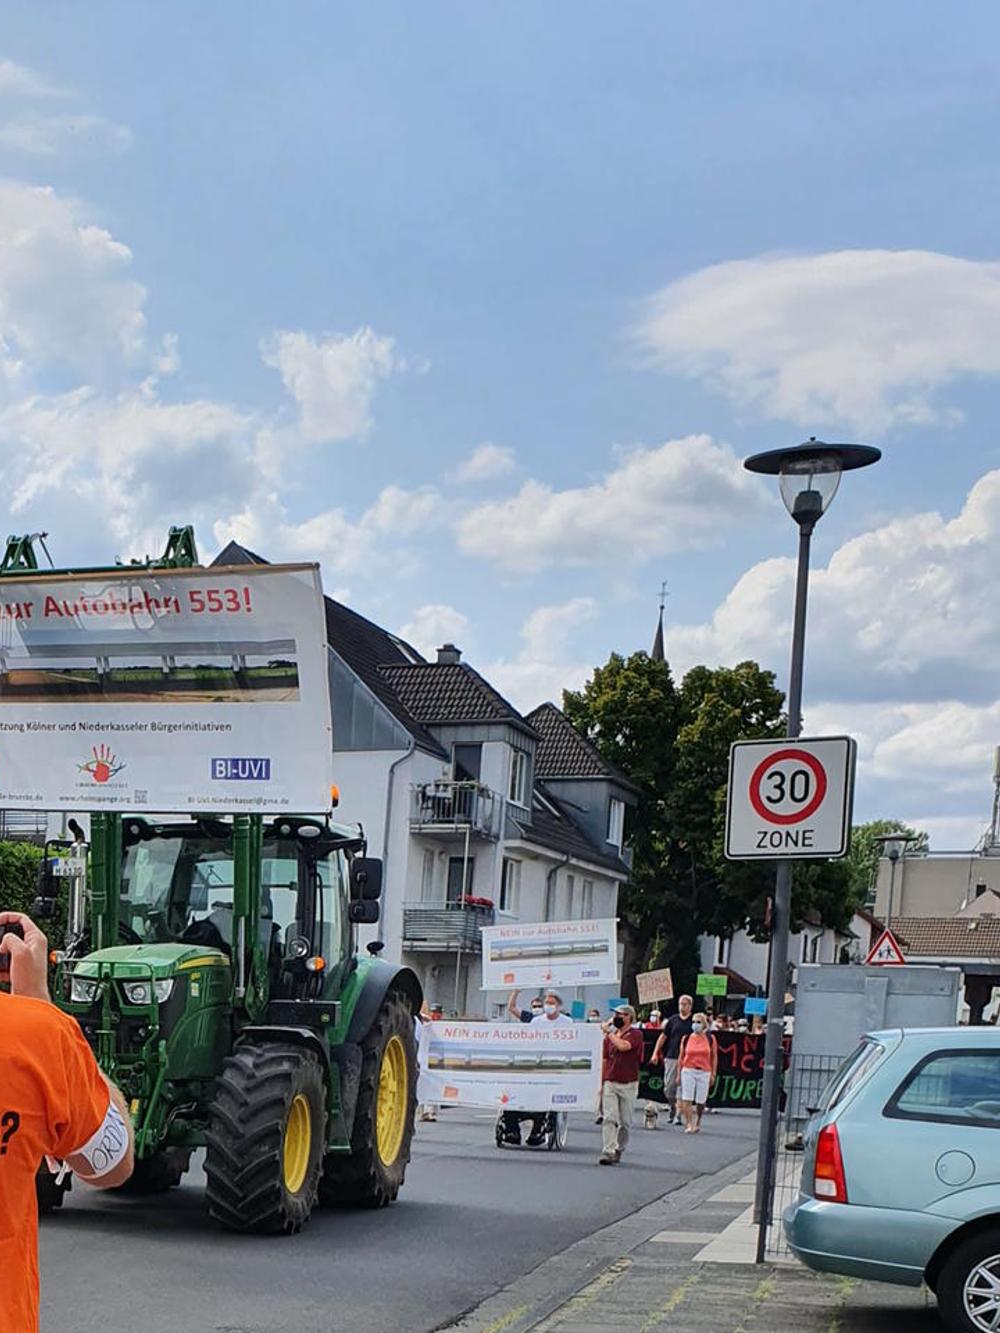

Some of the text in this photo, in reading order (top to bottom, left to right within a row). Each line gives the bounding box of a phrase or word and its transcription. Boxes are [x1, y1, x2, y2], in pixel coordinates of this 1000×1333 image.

[44, 590, 180, 617] Autobahn
[189, 587, 252, 613] 553!
[26, 721, 56, 731] Kölner
[58, 721, 77, 731] und
[79, 721, 148, 732] Niederkasseler
[151, 721, 232, 733] Bürgerinitiativen
[216, 760, 266, 778] BI-UVI
[766, 769, 810, 804] 30
[756, 829, 815, 849] ZONE
[444, 1028, 579, 1041] NEIN zur Autobahn 553!
